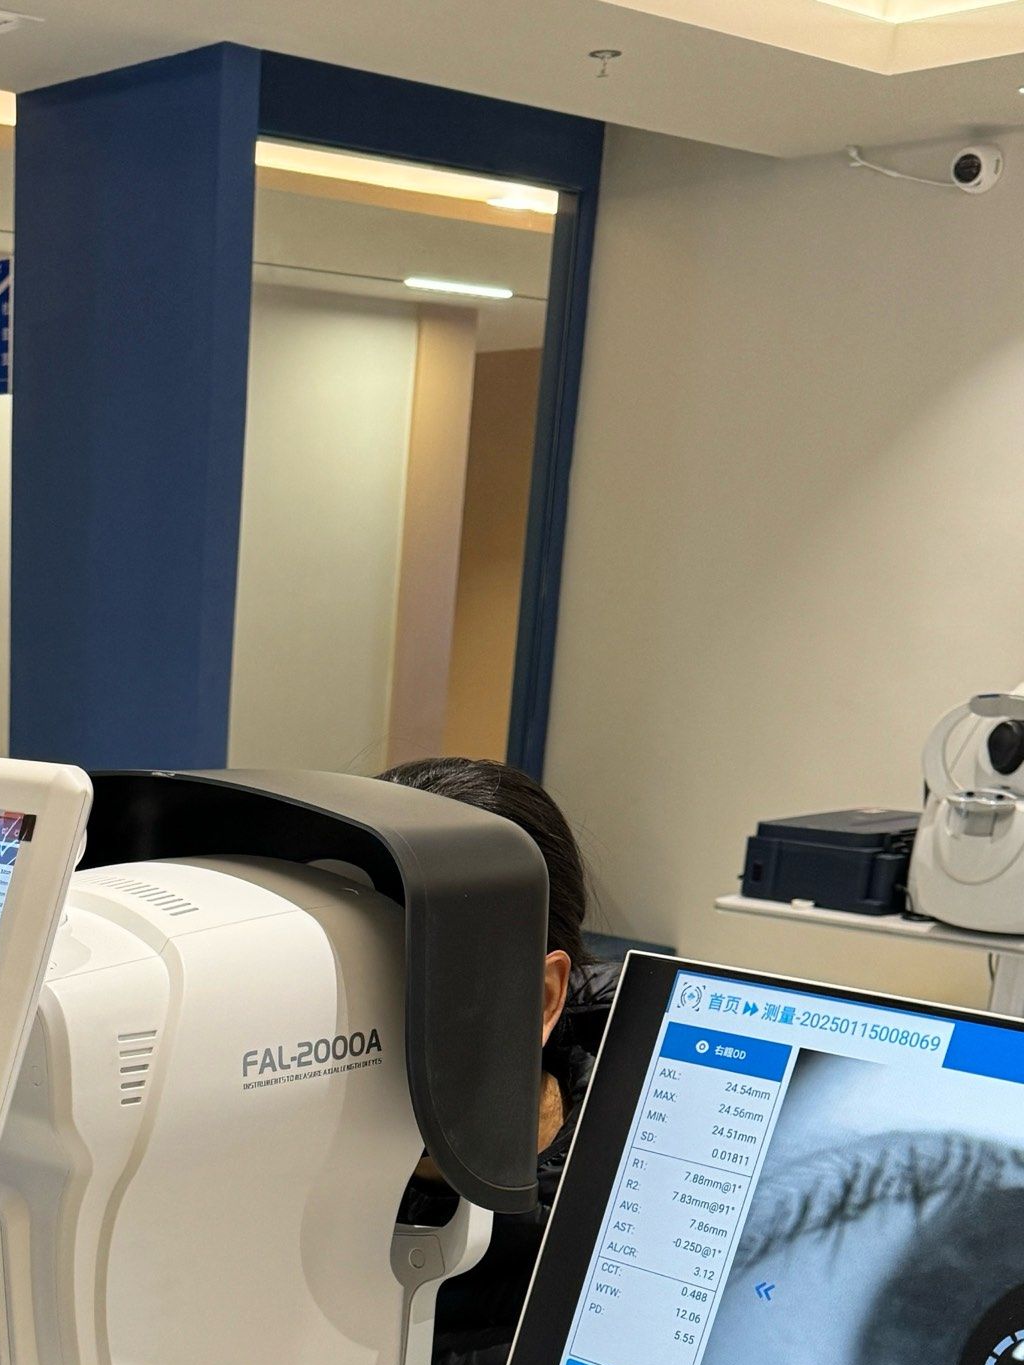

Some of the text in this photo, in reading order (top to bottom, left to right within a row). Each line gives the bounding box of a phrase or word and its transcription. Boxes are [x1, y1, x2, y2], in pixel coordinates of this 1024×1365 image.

[708, 993, 941, 1051] 首页 测量-20250115008069
[242, 1028, 382, 1077] FAL-2000A
[659, 1067, 771, 1101] AXL: 24.54mm
[653, 1088, 764, 1123] MAX: 24.56mm
[647, 1110, 757, 1145] MIN: 24.51mm
[640, 1131, 750, 1167] SD: 0.01811
[632, 1158, 742, 1194] R1: 7.88mm@1°
[626, 1178, 736, 1216] R2: 7.83mm@91°
[619, 1200, 728, 1238] AVG: 7.86mm
[613, 1221, 722, 1258] AST: -0.25D@1°
[607, 1241, 715, 1281] AL/CR: 3.12
[601, 1262, 708, 1302] CCT: 0.488
[595, 1283, 701, 1324] WTW: 12.06
[588, 1302, 695, 1345] PD: 5.55
